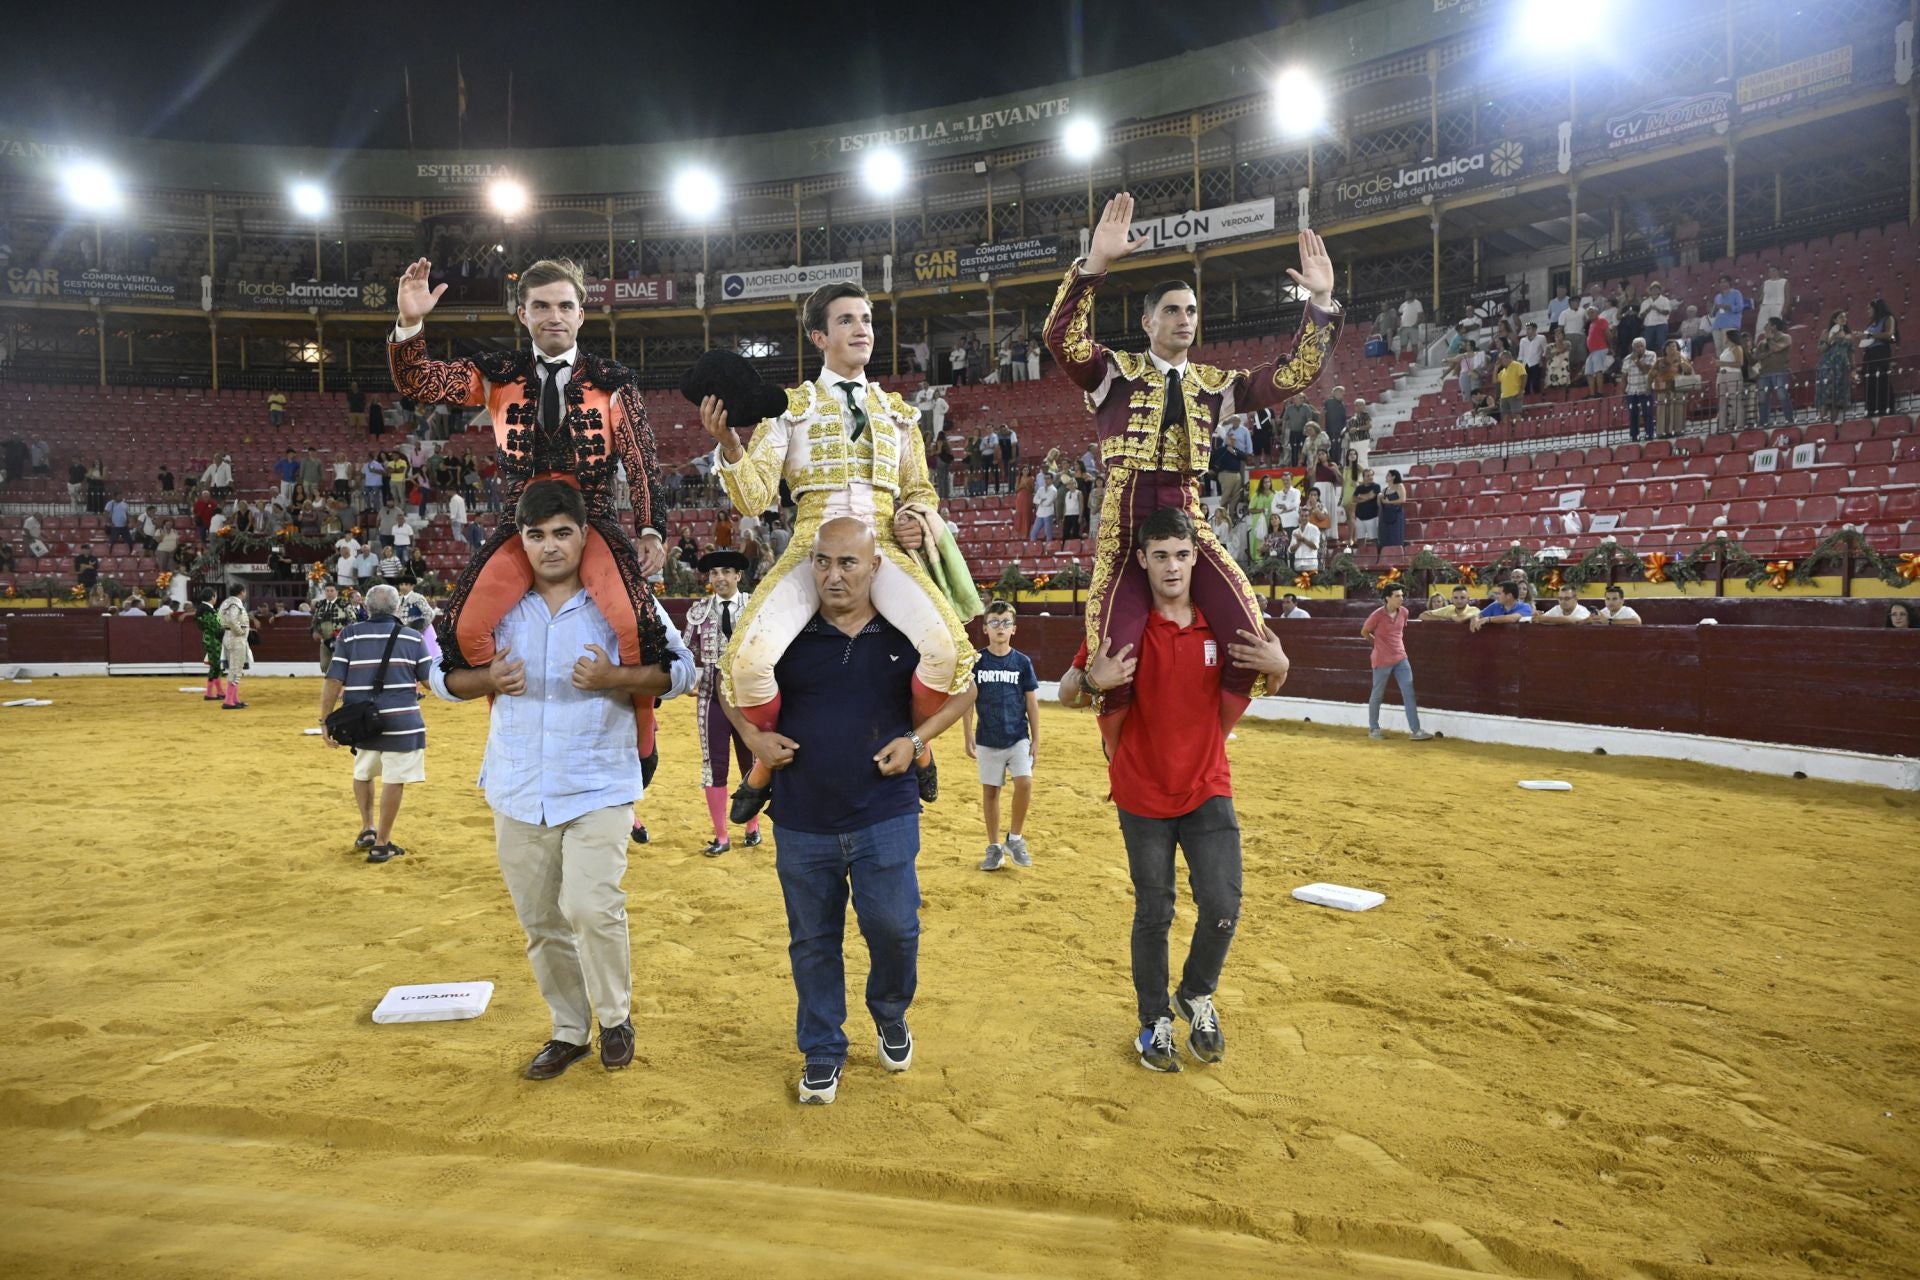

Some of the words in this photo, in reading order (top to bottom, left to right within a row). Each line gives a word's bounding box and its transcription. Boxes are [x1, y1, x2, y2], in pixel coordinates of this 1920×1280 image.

[839, 120, 948, 152] ESTRELLA
[952, 121, 965, 132] DE
[967, 97, 1070, 133] LEVANTE
[1612, 119, 1642, 139] GV
[1644, 96, 1730, 133] MOTOR
[1608, 139, 1621, 150] SU
[1623, 129, 1657, 146] TALLER
[1659, 126, 1672, 136] DE
[1673, 112, 1729, 132] CONFIANZA
[416, 164, 509, 177] ESTRELLA
[1354, 195, 1383, 209] Cafés
[1410, 185, 1426, 196] del
[1428, 176, 1465, 192] Mundo
[1221, 213, 1265, 228] VERDOLAY
[975, 239, 1041, 256] COMPRA-VENTA
[914, 249, 957, 267] CAR
[960, 254, 997, 267] GESTIÓN
[997, 253, 1009, 263] DE
[1010, 246, 1057, 260] VEHÍCULOS
[7, 267, 60, 281] CAR
[745, 273, 797, 287] MORENO
[808, 266, 861, 282] SCHMIDT
[914, 263, 957, 281] WIN
[978, 265, 987, 273] DE
[8, 280, 60, 295] WIN
[64, 279, 105, 290] GESTIÓN
[107, 281, 120, 290] DE
[122, 282, 175, 293] VEHÍCULOS
[615, 281, 658, 298] ENAE
[253, 295, 278, 305] Cafés
[300, 296, 313, 305] del
[315, 297, 344, 306] Mundo
[977, 669, 1020, 685] FORTNITE
